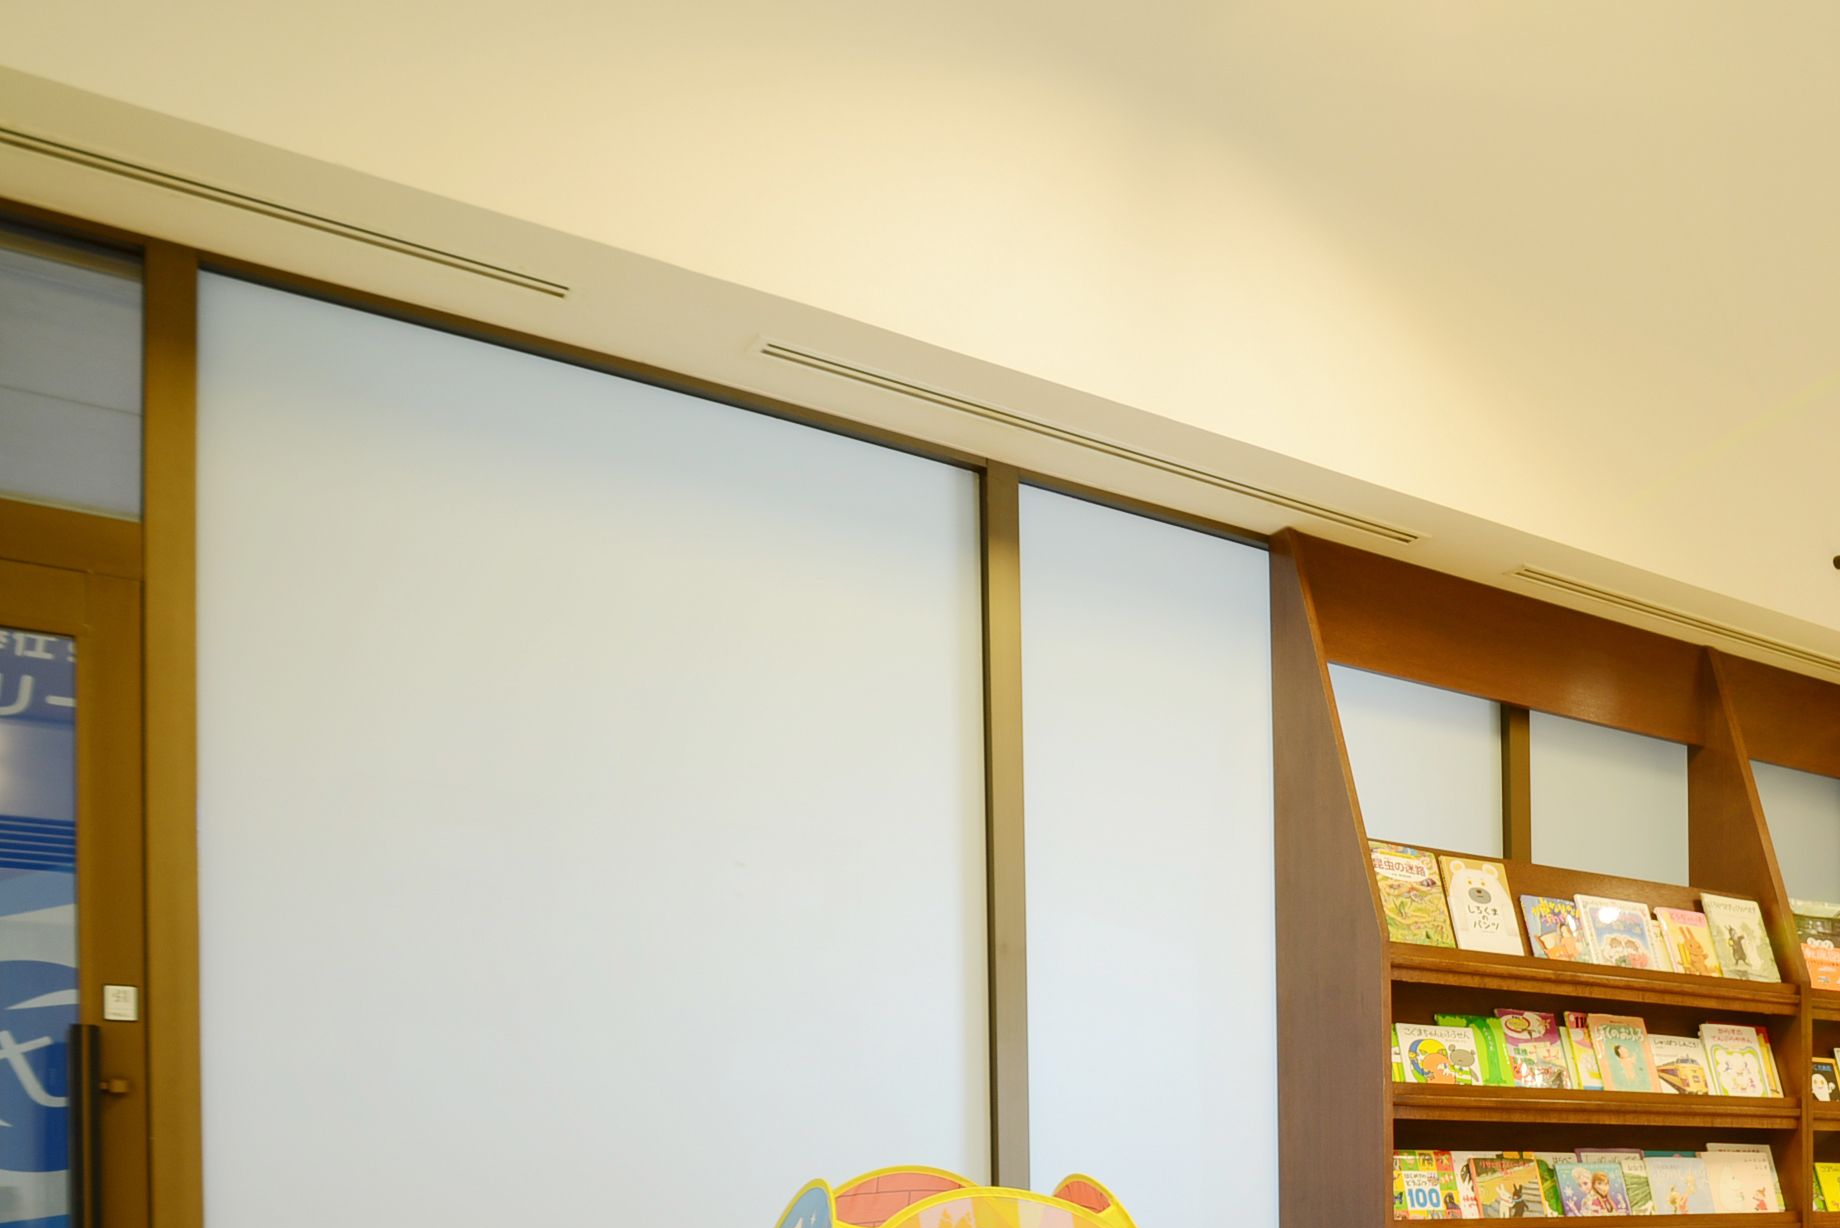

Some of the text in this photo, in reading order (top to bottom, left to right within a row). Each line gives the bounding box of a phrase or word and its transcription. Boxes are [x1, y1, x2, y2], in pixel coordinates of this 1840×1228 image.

[1467, 904, 1498, 916] しろくま
[1407, 1188, 1441, 1208] 100
